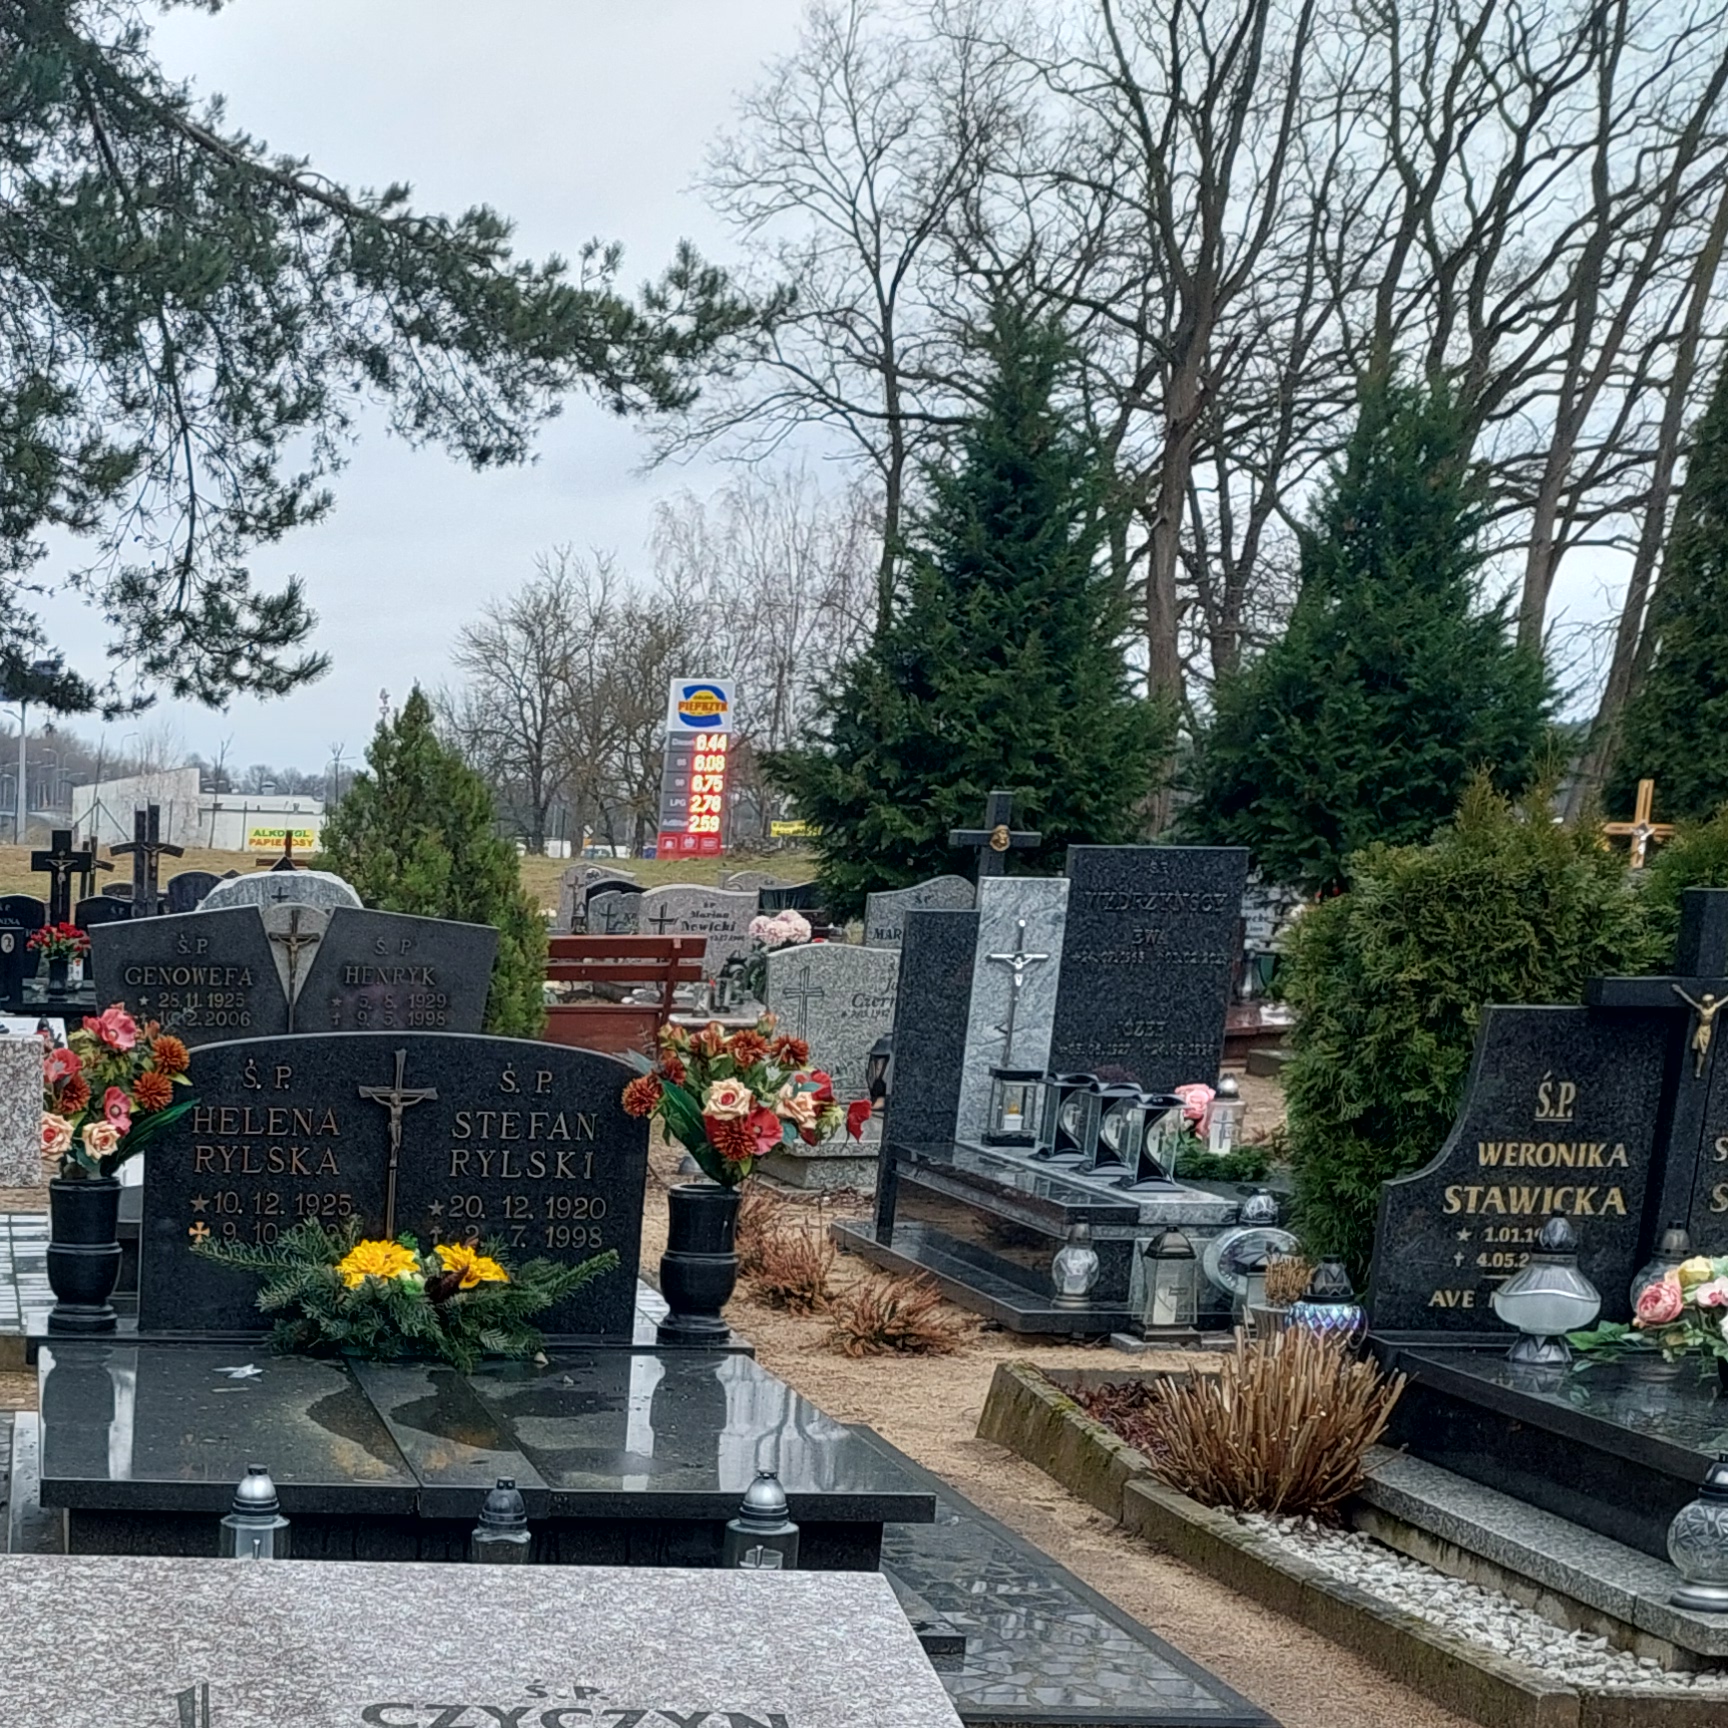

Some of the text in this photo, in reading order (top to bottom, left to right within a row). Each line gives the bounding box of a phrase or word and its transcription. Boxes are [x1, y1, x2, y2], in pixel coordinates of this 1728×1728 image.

[669, 798, 687, 807] LPG
[253, 829, 310, 837] ALKOOL
[681, 921, 737, 932] Nowicki
[124, 966, 253, 986] GENOWEFA
[344, 966, 436, 986] HENRYK
[408, 993, 447, 1009] 1929
[408, 1011, 446, 1027] 1998
[192, 1105, 341, 1136] HELENA
[451, 1111, 599, 1141] STEFAN
[194, 1145, 341, 1175] RYLSKA
[449, 1150, 595, 1179] RYLSKI
[1478, 1142, 1629, 1168] WERONIKA
[295, 1193, 352, 1216] 1925
[545, 1196, 607, 1219] 1920
[1443, 1186, 1627, 1216] STAWICKA
[546, 1225, 603, 1248] 1998
[1428, 1290, 1476, 1308] AVE
